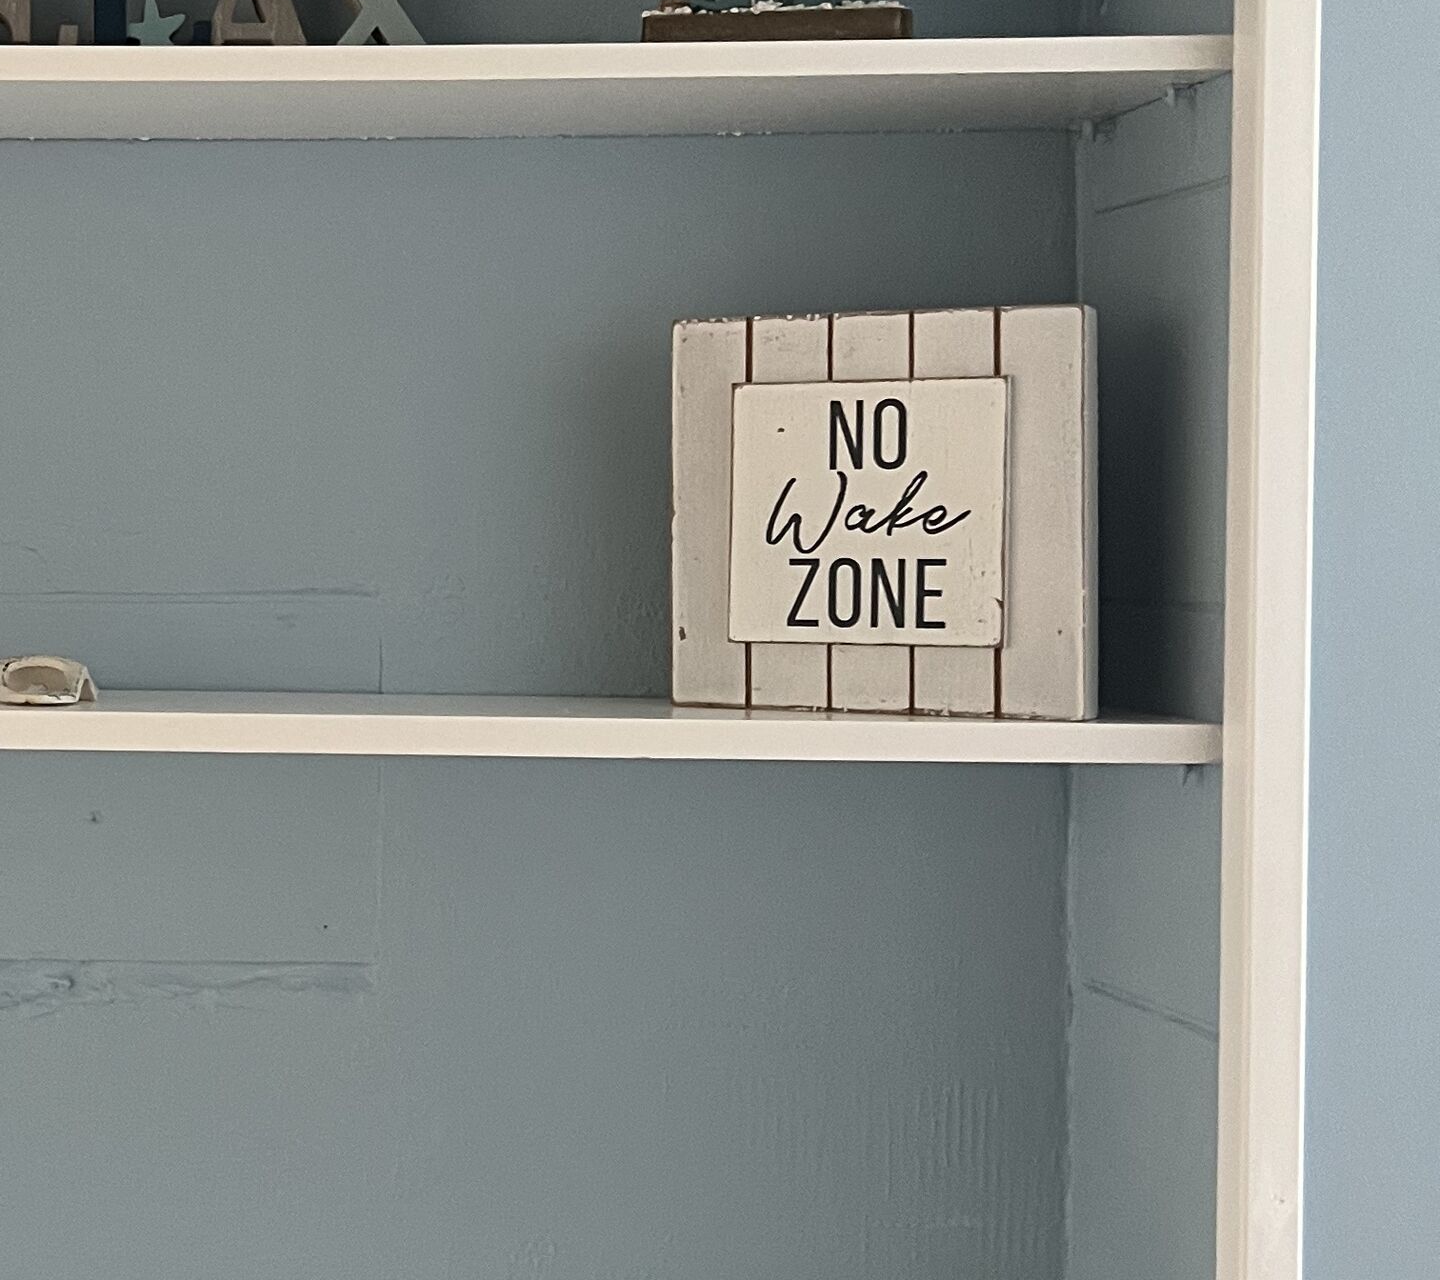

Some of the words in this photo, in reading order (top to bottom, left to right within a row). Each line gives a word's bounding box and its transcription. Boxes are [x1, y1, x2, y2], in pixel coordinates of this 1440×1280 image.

[828, 397, 908, 470] NO
[765, 470, 971, 554] Wake
[786, 557, 947, 629] ZONE
